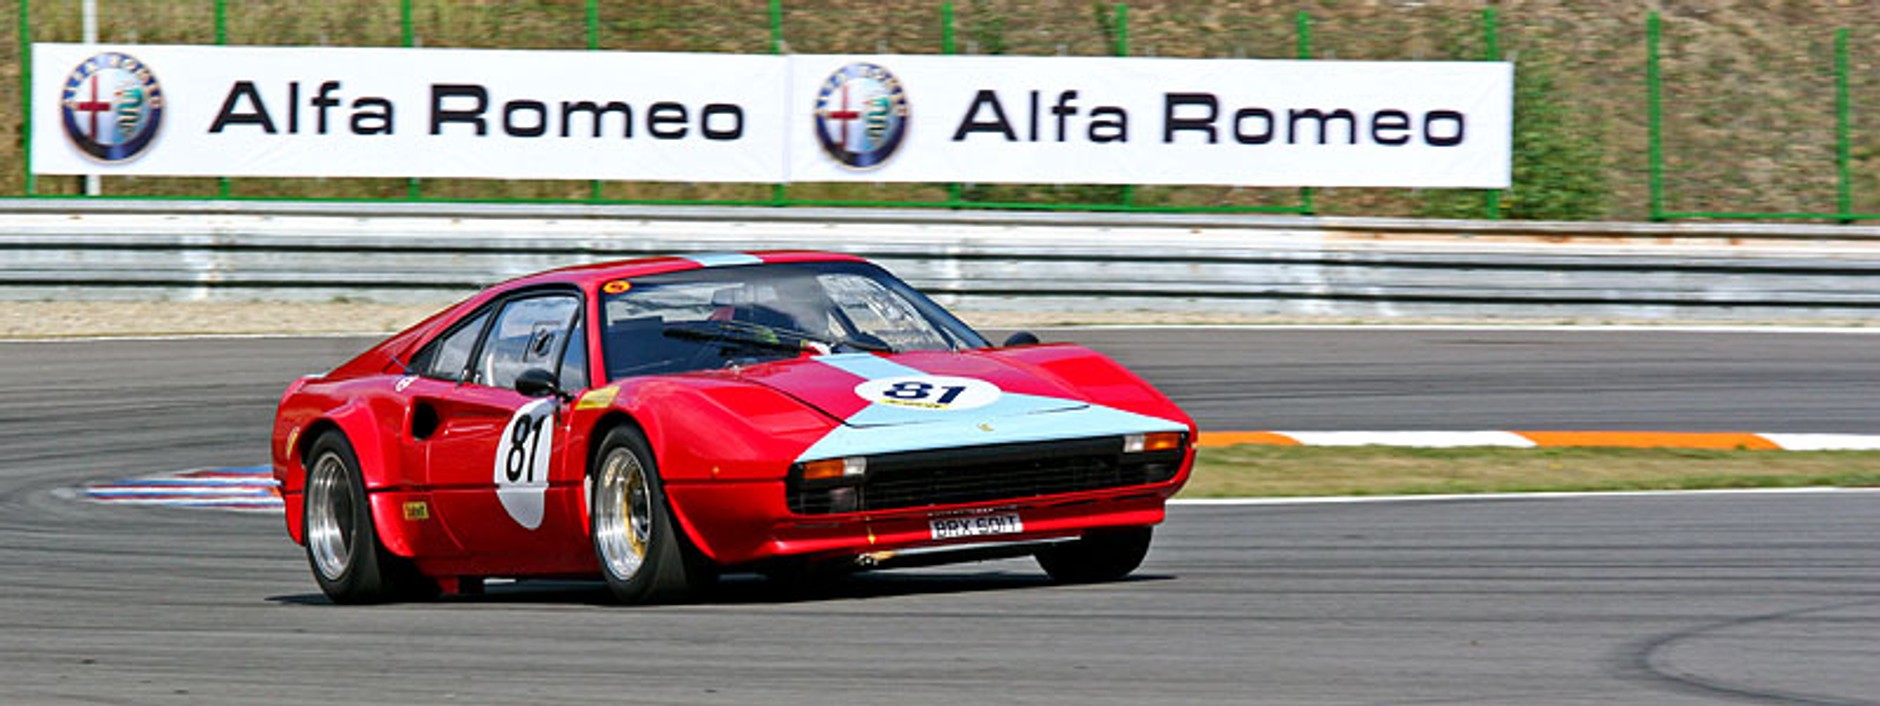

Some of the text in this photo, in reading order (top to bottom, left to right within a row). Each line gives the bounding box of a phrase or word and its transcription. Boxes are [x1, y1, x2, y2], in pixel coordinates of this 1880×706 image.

[208, 80, 395, 136] Alfa
[428, 83, 746, 141] Romeo
[952, 89, 1129, 143] Alfa
[1162, 92, 1466, 147] Romeo
[883, 381, 966, 404] 81
[506, 414, 547, 483] 81
